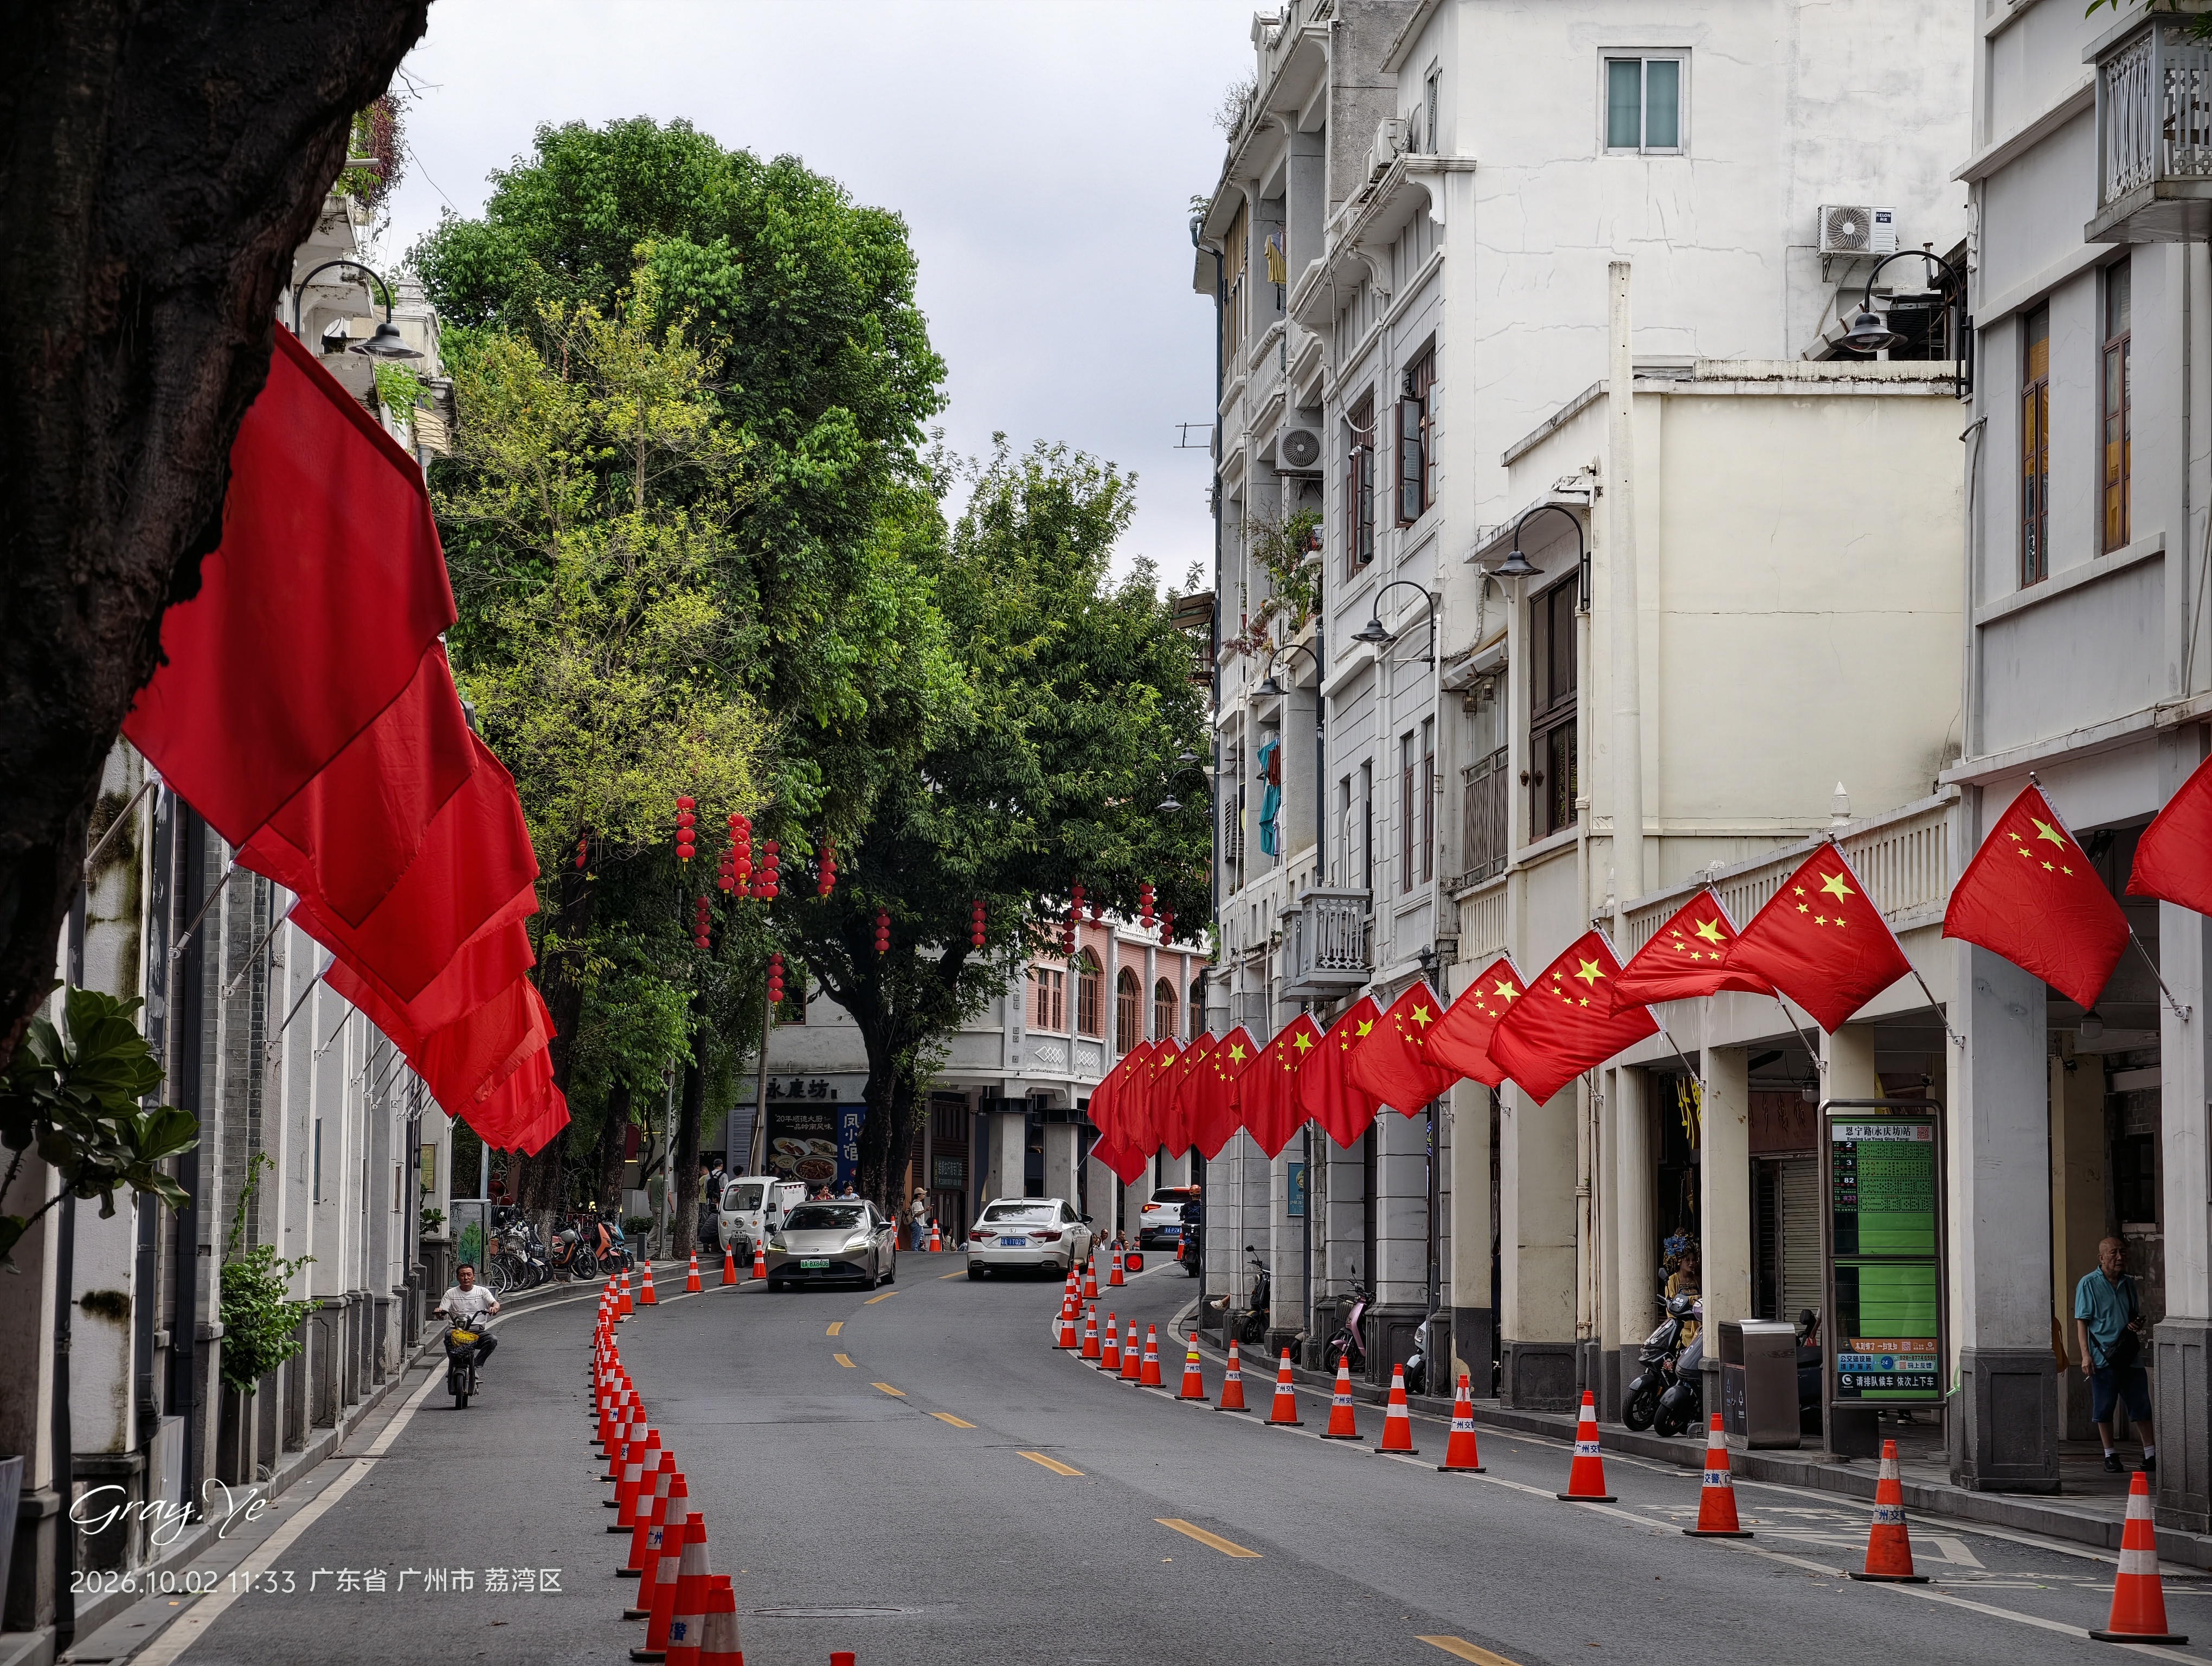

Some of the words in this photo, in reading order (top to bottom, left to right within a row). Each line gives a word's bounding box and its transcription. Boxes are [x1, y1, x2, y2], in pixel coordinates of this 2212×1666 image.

[1846, 1126, 1911, 1136] 恩宁路(永庆坊)站
[1856, 1376, 1894, 1387] 请排队候车
[1897, 1376, 1934, 1387] 依次上下车
